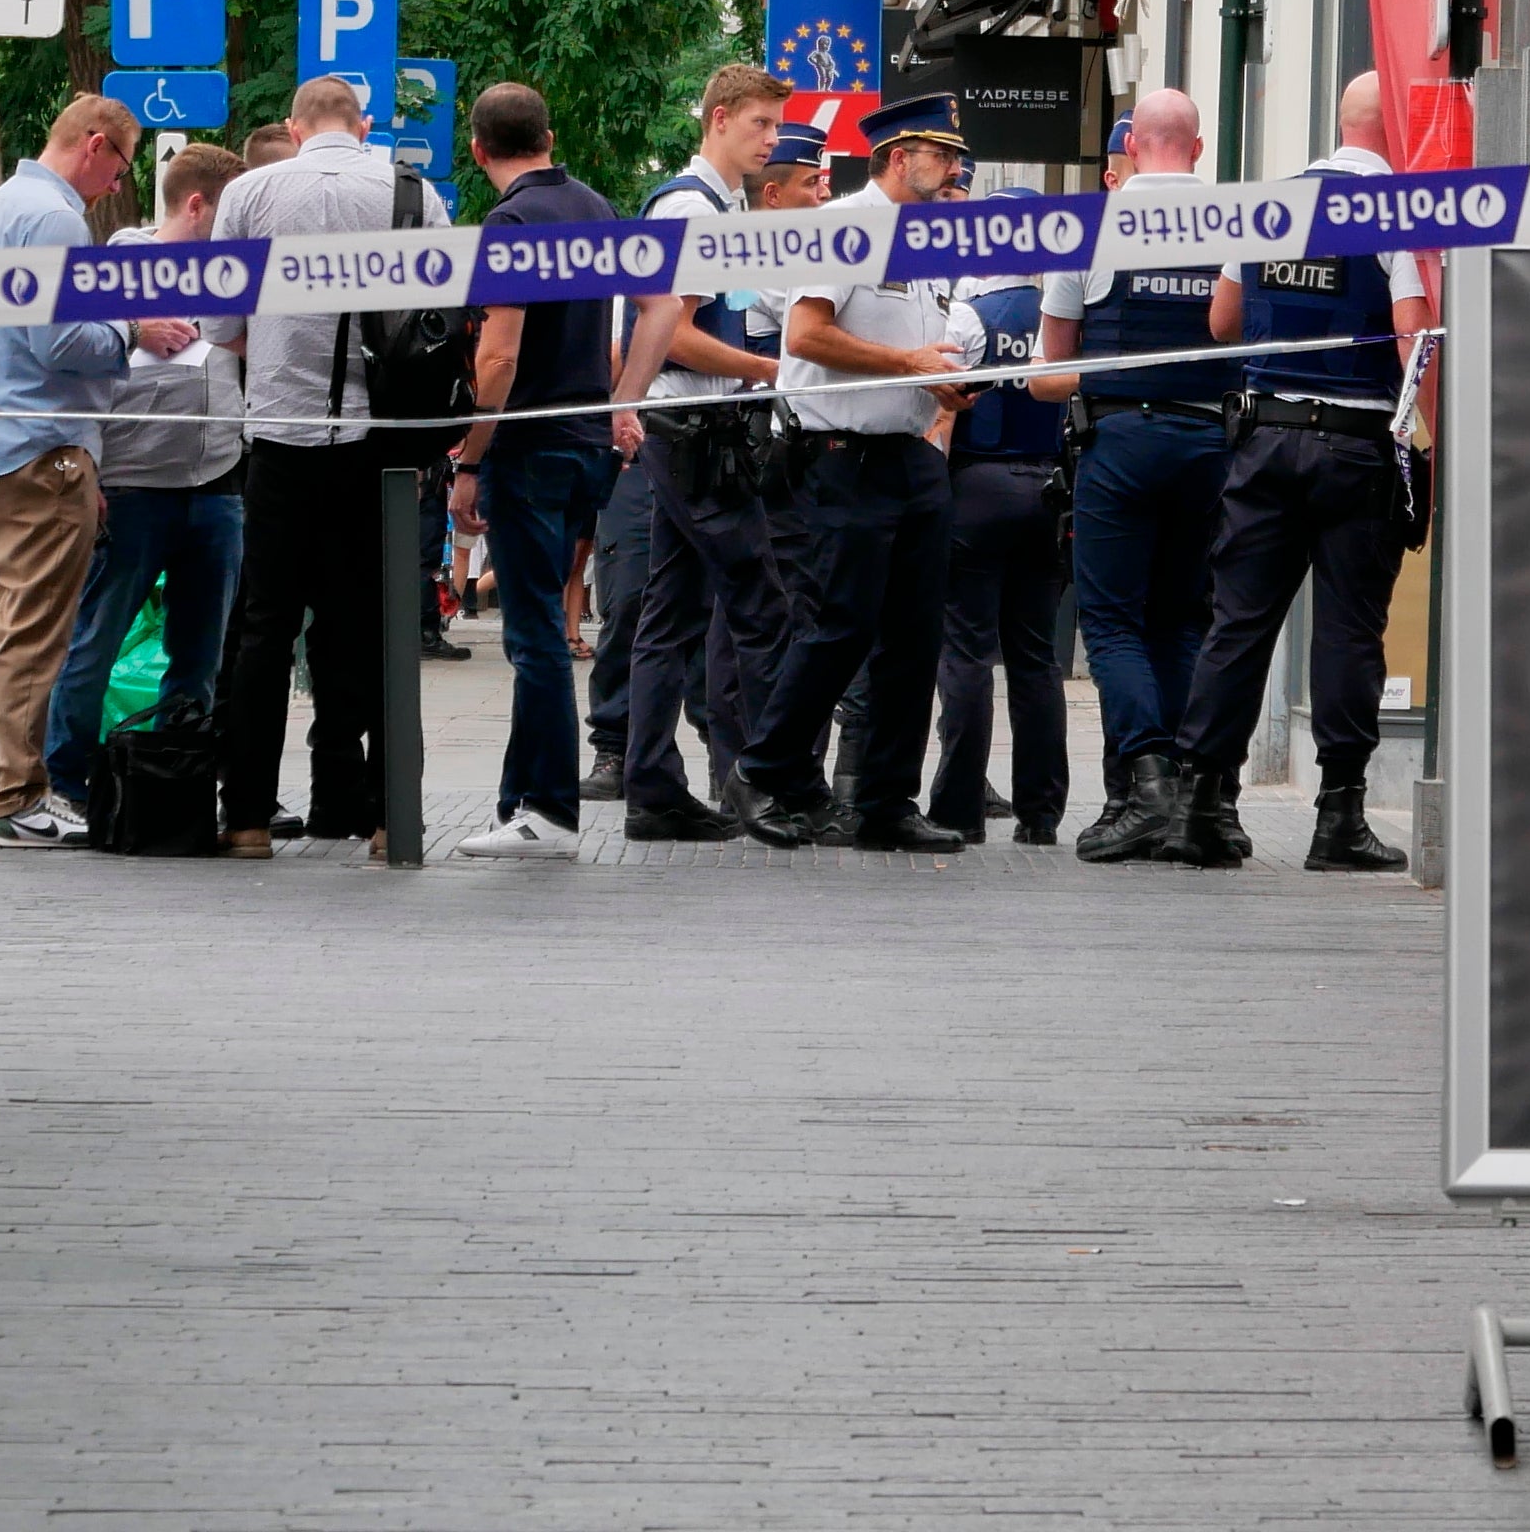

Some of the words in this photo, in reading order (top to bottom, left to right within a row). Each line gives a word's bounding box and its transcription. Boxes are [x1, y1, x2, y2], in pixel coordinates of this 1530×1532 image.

[965, 89, 1069, 101] L'ADRESSE
[1119, 203, 1243, 245] Politie
[1327, 187, 1456, 231] Police
[699, 229, 823, 268] Politie
[905, 213, 1035, 257] Police
[72, 258, 200, 300] Police
[281, 251, 405, 291] Politie
[487, 238, 616, 280] Police
[1264, 262, 1336, 289] POLITIE
